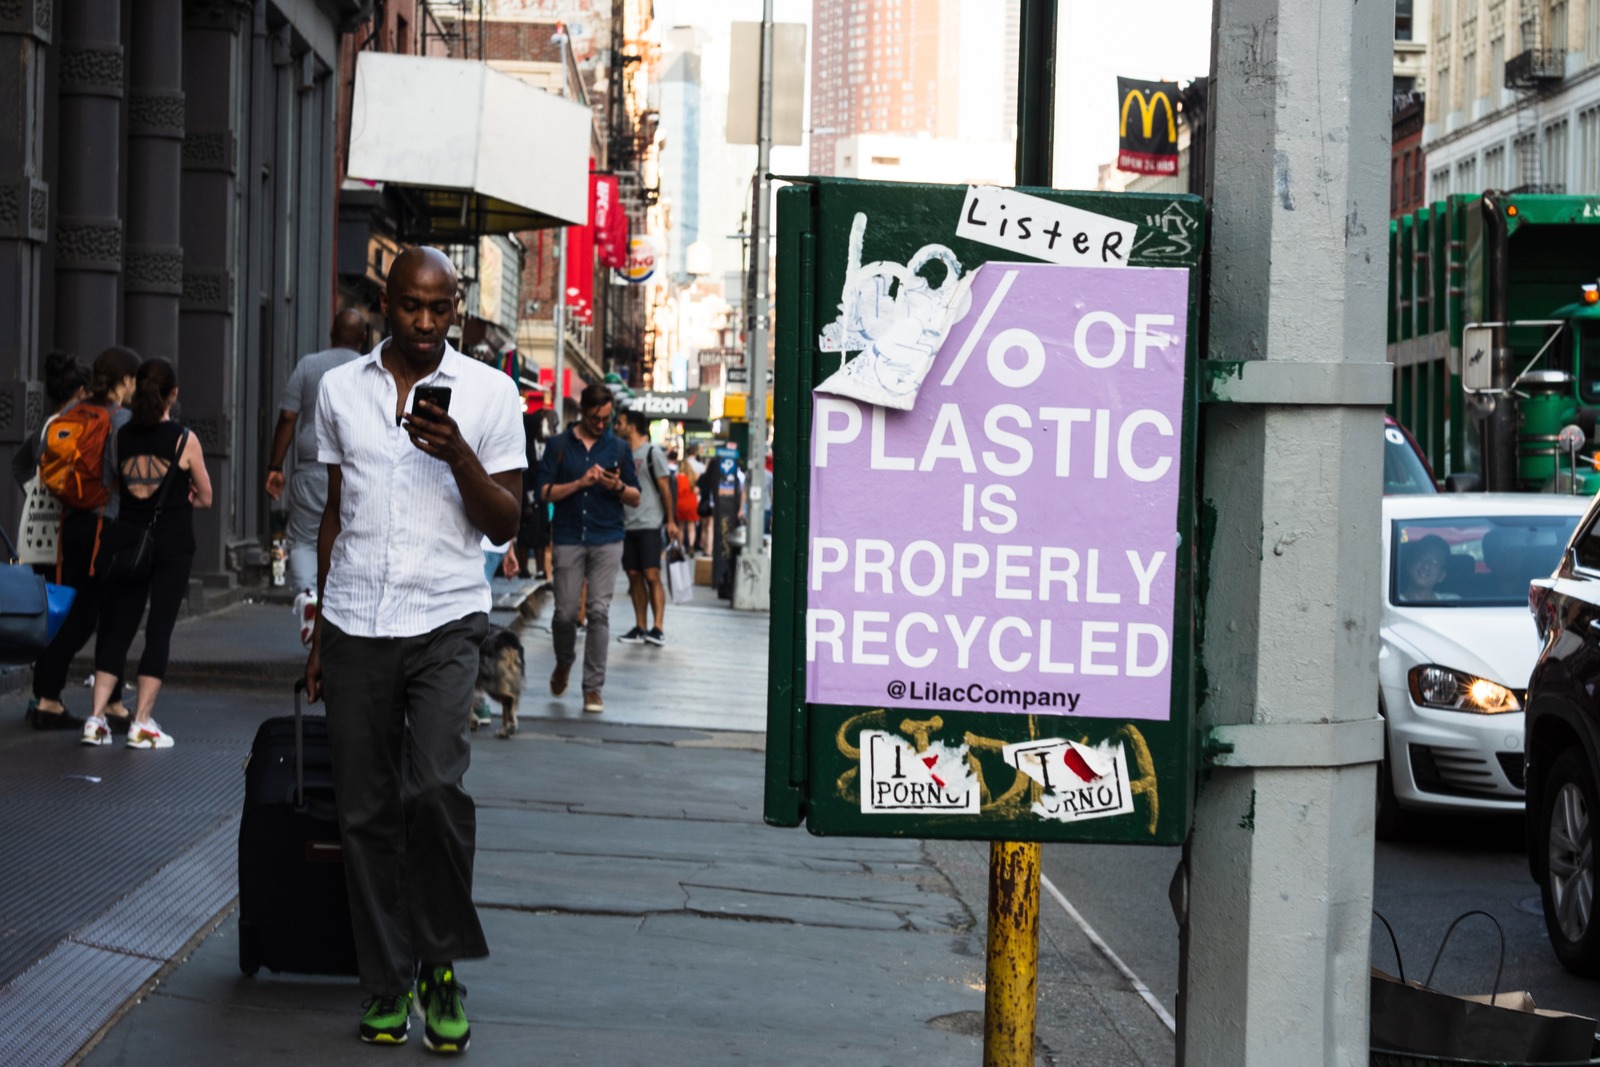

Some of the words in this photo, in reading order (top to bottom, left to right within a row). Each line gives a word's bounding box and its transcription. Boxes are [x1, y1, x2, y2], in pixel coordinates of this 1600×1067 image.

[1073, 310, 1175, 369] OF
[629, 392, 688, 414] rizon
[814, 398, 1175, 482] PLASTIC
[962, 484, 1018, 534] IS
[26, 539, 53, 549] YOR
[811, 536, 1167, 606] PROPERLY
[806, 608, 1170, 678] RECYCLED
[887, 680, 1081, 712] @LilacCompany
[891, 745, 907, 779] I
[1034, 751, 1056, 790] I
[1047, 785, 1113, 814] RNO
